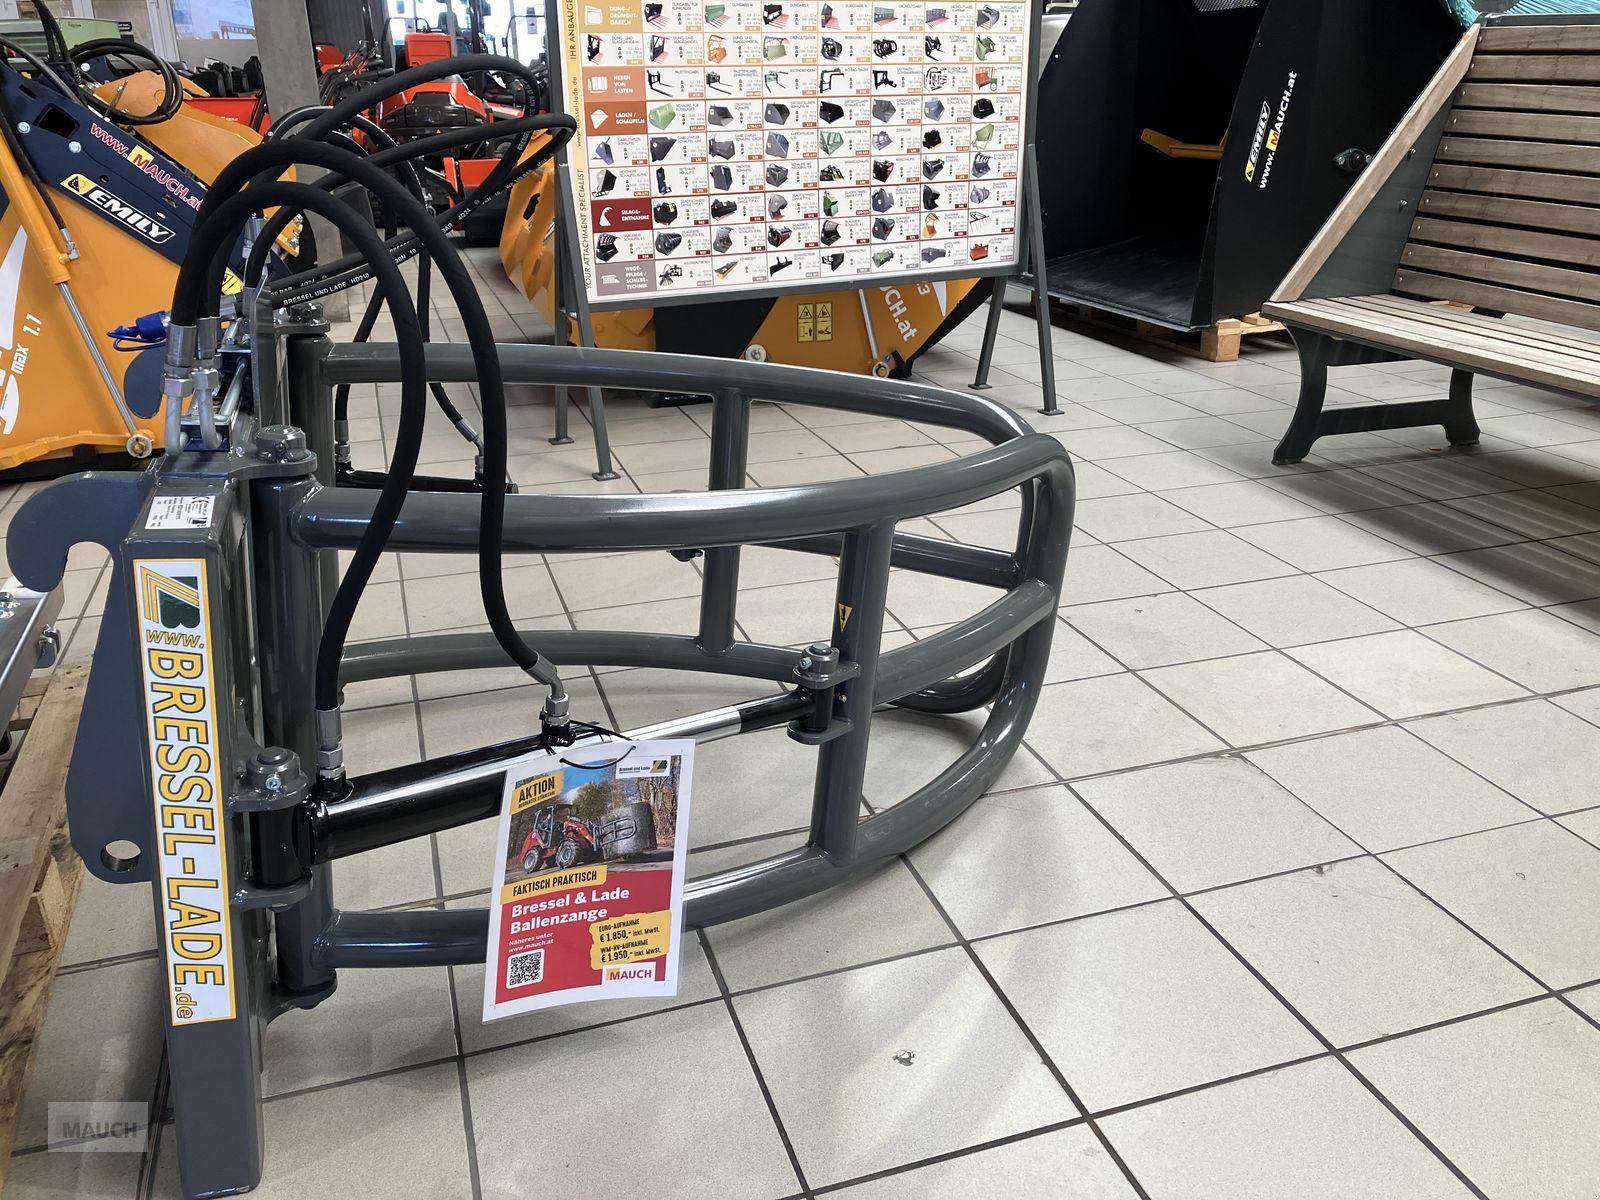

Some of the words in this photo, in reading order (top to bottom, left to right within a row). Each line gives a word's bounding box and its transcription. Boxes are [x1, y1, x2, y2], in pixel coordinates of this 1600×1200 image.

[569, 45, 577, 60] IHR
[1259, 70, 1298, 189] www.MAUCH.at
[576, 169, 587, 213] SPECIALIST
[89, 189, 169, 239] EMILY
[579, 214, 591, 267] ATTACHMENT
[583, 268, 593, 290] YOUR
[282, 293, 314, 306] BRESSEL
[314, 288, 329, 297] UND
[329, 281, 347, 292] LADE
[880, 286, 918, 342] CH.at
[11, 343, 30, 375] max
[22, 312, 43, 337] 1.1
[145, 629, 205, 649] www.
[518, 776, 555, 803] AKTION
[513, 877, 551, 897] FAKTISCH
[552, 870, 597, 888] PRAKTISCH
[511, 894, 571, 918] Bressel
[574, 891, 587, 905] &
[591, 887, 630, 902] Lade
[510, 908, 608, 935] Ballenzange
[598, 919, 640, 932] EURO-AUFNAHME
[508, 936, 535, 947] Näheres
[536, 932, 553, 940] unter
[508, 938, 554, 953] www.mauch.at
[600, 934, 605, 943] €
[601, 954, 606, 963] €
[609, 969, 652, 981] MAUCH
